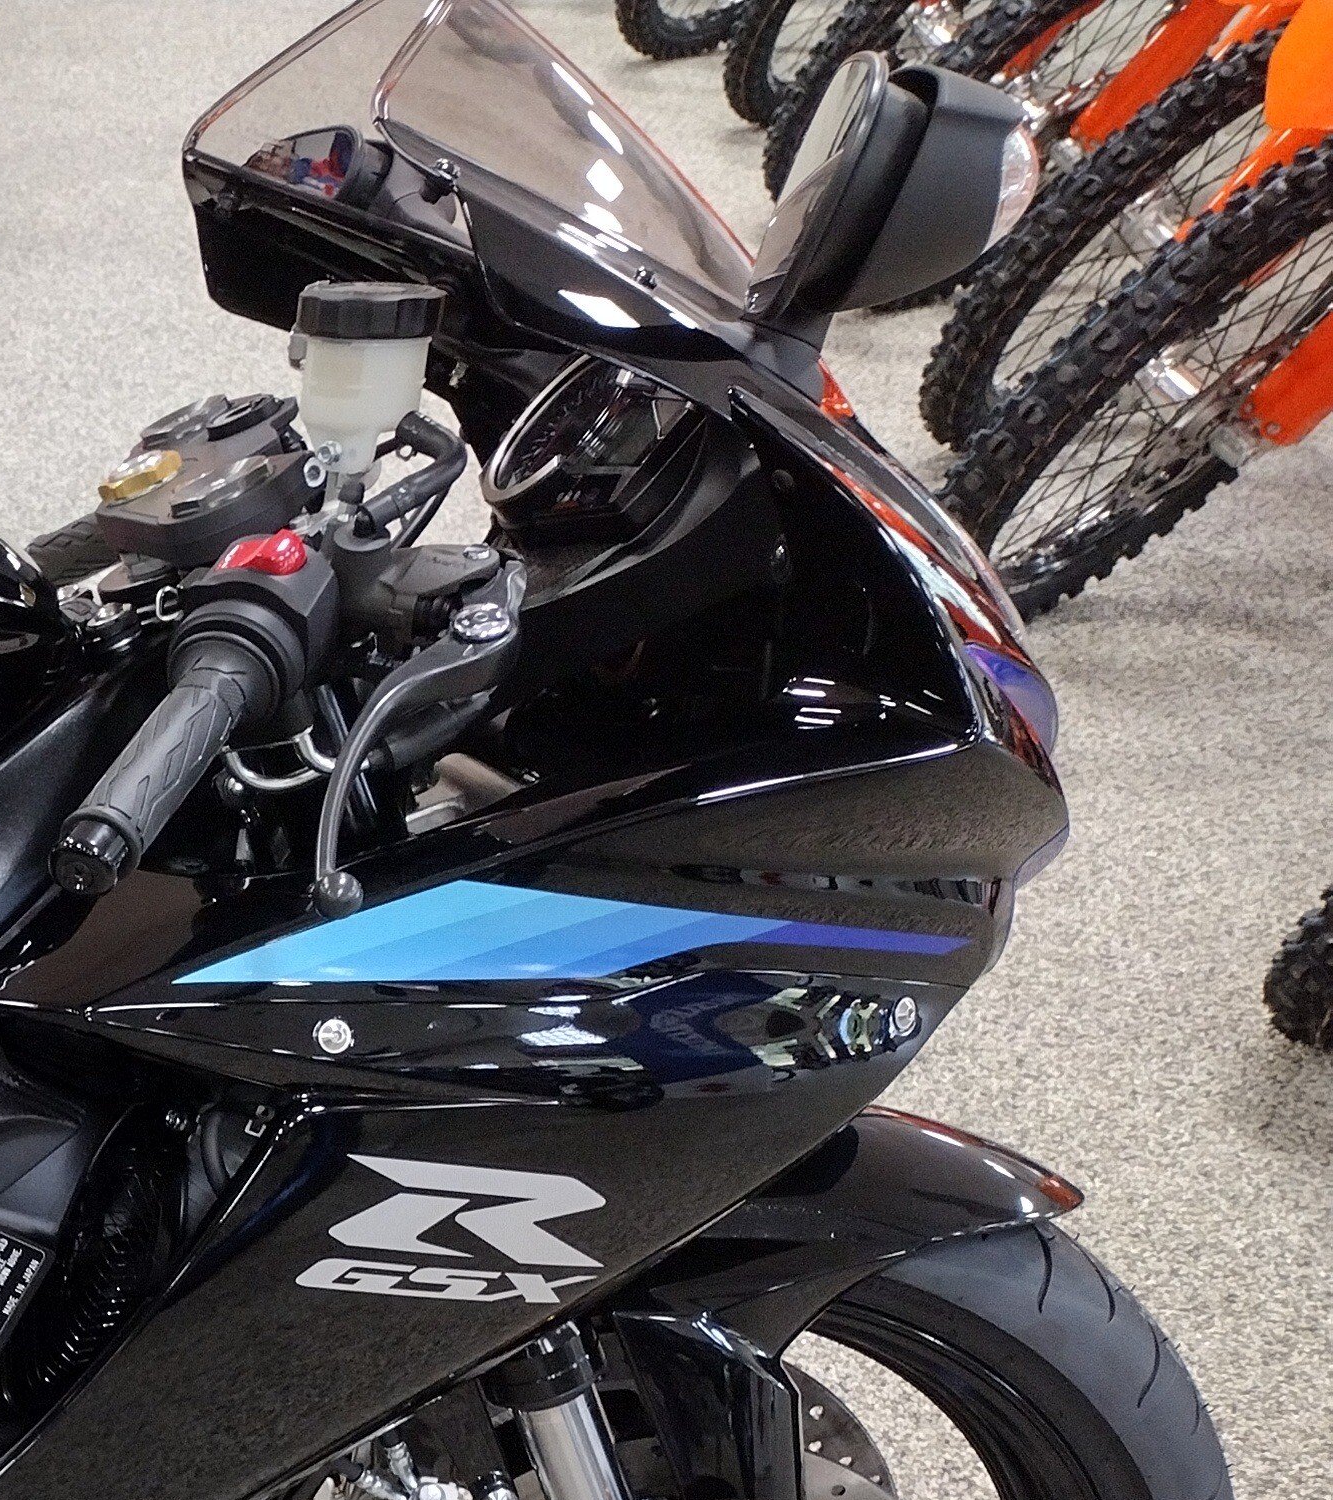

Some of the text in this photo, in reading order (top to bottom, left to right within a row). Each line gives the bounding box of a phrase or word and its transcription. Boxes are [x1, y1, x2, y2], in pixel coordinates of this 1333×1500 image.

[328, 1154, 607, 1268] R
[20, 1257, 40, 1283] JAPAN
[295, 1257, 600, 1304] GSX
